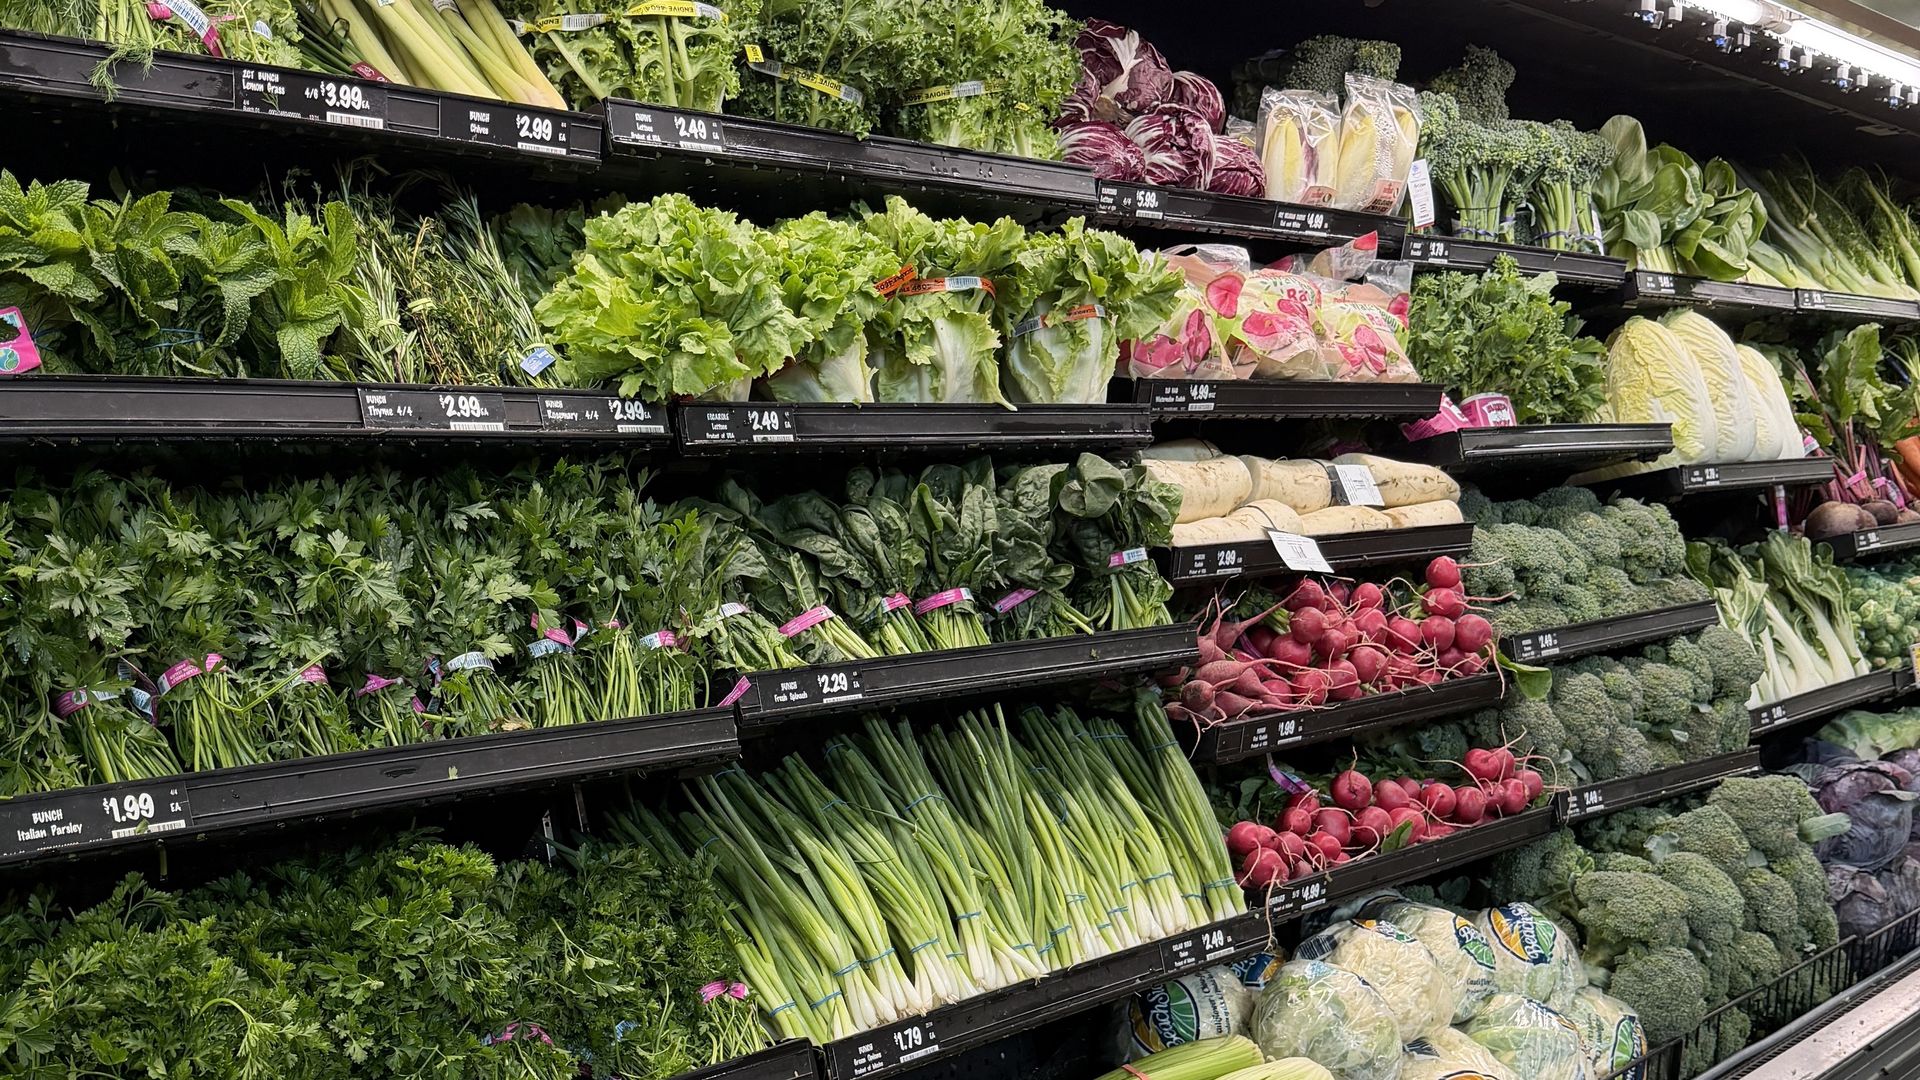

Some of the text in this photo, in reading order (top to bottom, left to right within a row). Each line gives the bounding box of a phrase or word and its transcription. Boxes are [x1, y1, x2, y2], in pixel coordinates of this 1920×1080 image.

[670, 6, 694, 14] ENDIVE
[258, 72, 280, 82] BUNCH
[819, 78, 842, 91] ENDIVE
[242, 80, 286, 96] Lemon Grass
[304, 81, 370, 110] 4/6 $3.99 EA
[925, 90, 950, 100] ENDIVE
[470, 110, 490, 122] BUNCH
[516, 114, 552, 142] $2.99
[674, 116, 706, 140] $2.49
[558, 133, 566, 142] EA
[1136, 190, 1156, 208] $5.99
[1307, 213, 1324, 229] $4.99
[366, 395, 386, 404] BUNCH
[1190, 384, 1209, 400] $4.99
[368, 406, 413, 417] Thyme 4/4
[439, 394, 480, 418] $2.99
[608, 400, 644, 421] $2.99
[547, 410, 599, 421] Rosemary 4/4
[748, 410, 778, 430] $2.49
[1217, 550, 1236, 566] $2.99
[817, 672, 848, 694] $2.29
[1278, 720, 1295, 736] $1.99
[102, 792, 154, 823] $1.99
[170, 802, 182, 813] EA
[32, 808, 63, 824] BUNCH
[17, 823, 82, 842] Italian Parsley
[1302, 883, 1320, 901] $4.99
[1202, 930, 1224, 950] $2.49
[1209, 998, 1222, 1033] auliflower
[894, 1026, 922, 1051] $1.79
